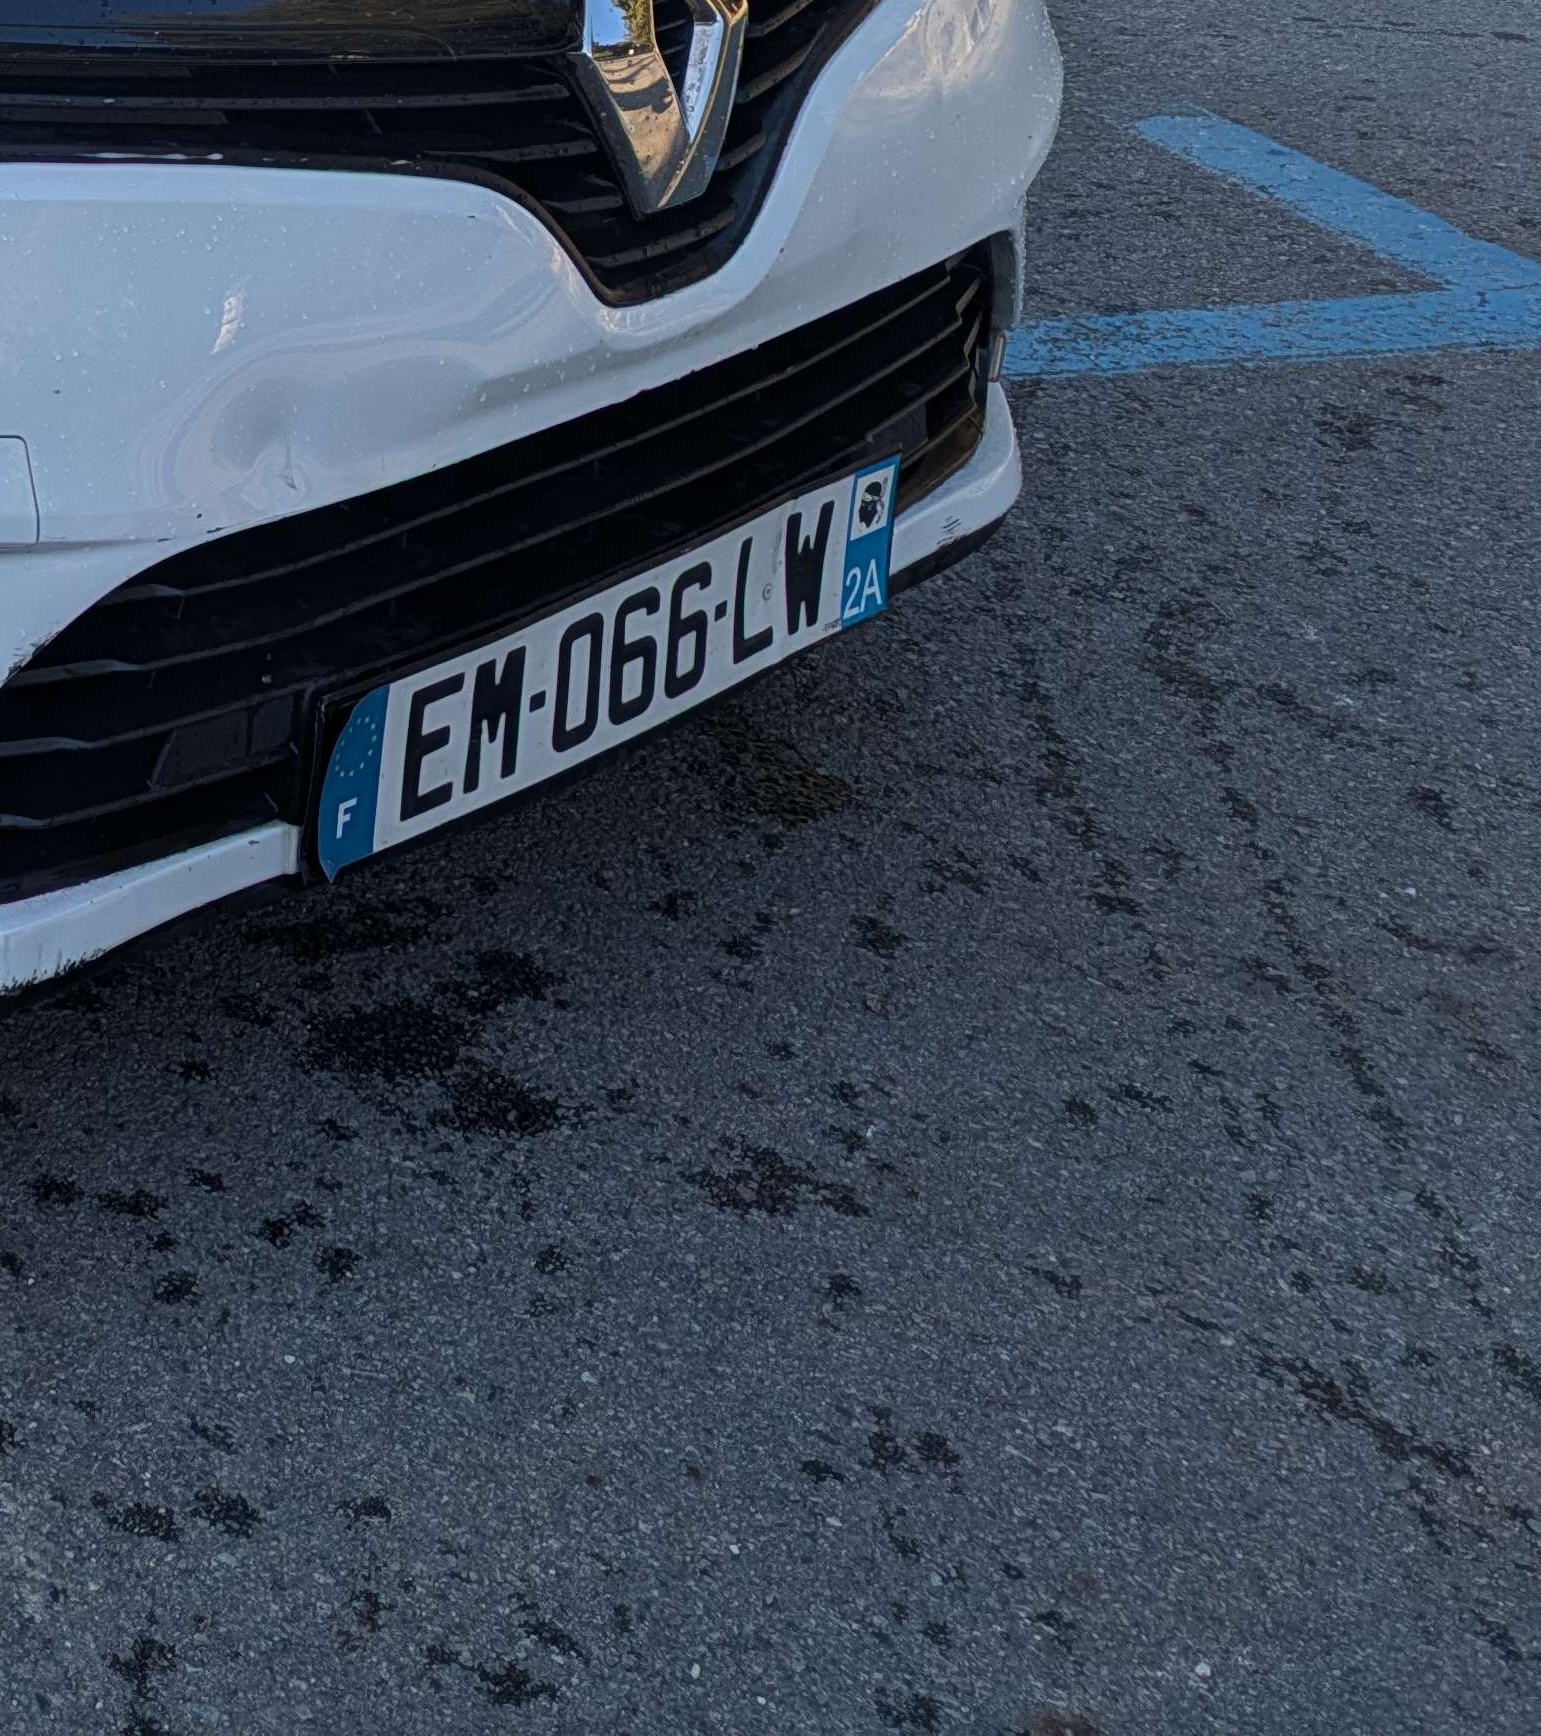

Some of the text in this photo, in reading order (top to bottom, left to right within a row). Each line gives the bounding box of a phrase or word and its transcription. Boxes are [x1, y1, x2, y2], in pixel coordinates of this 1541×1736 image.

[843, 558, 883, 620] 2A
[400, 499, 835, 823] EM-066-LW
[335, 797, 358, 839] F
